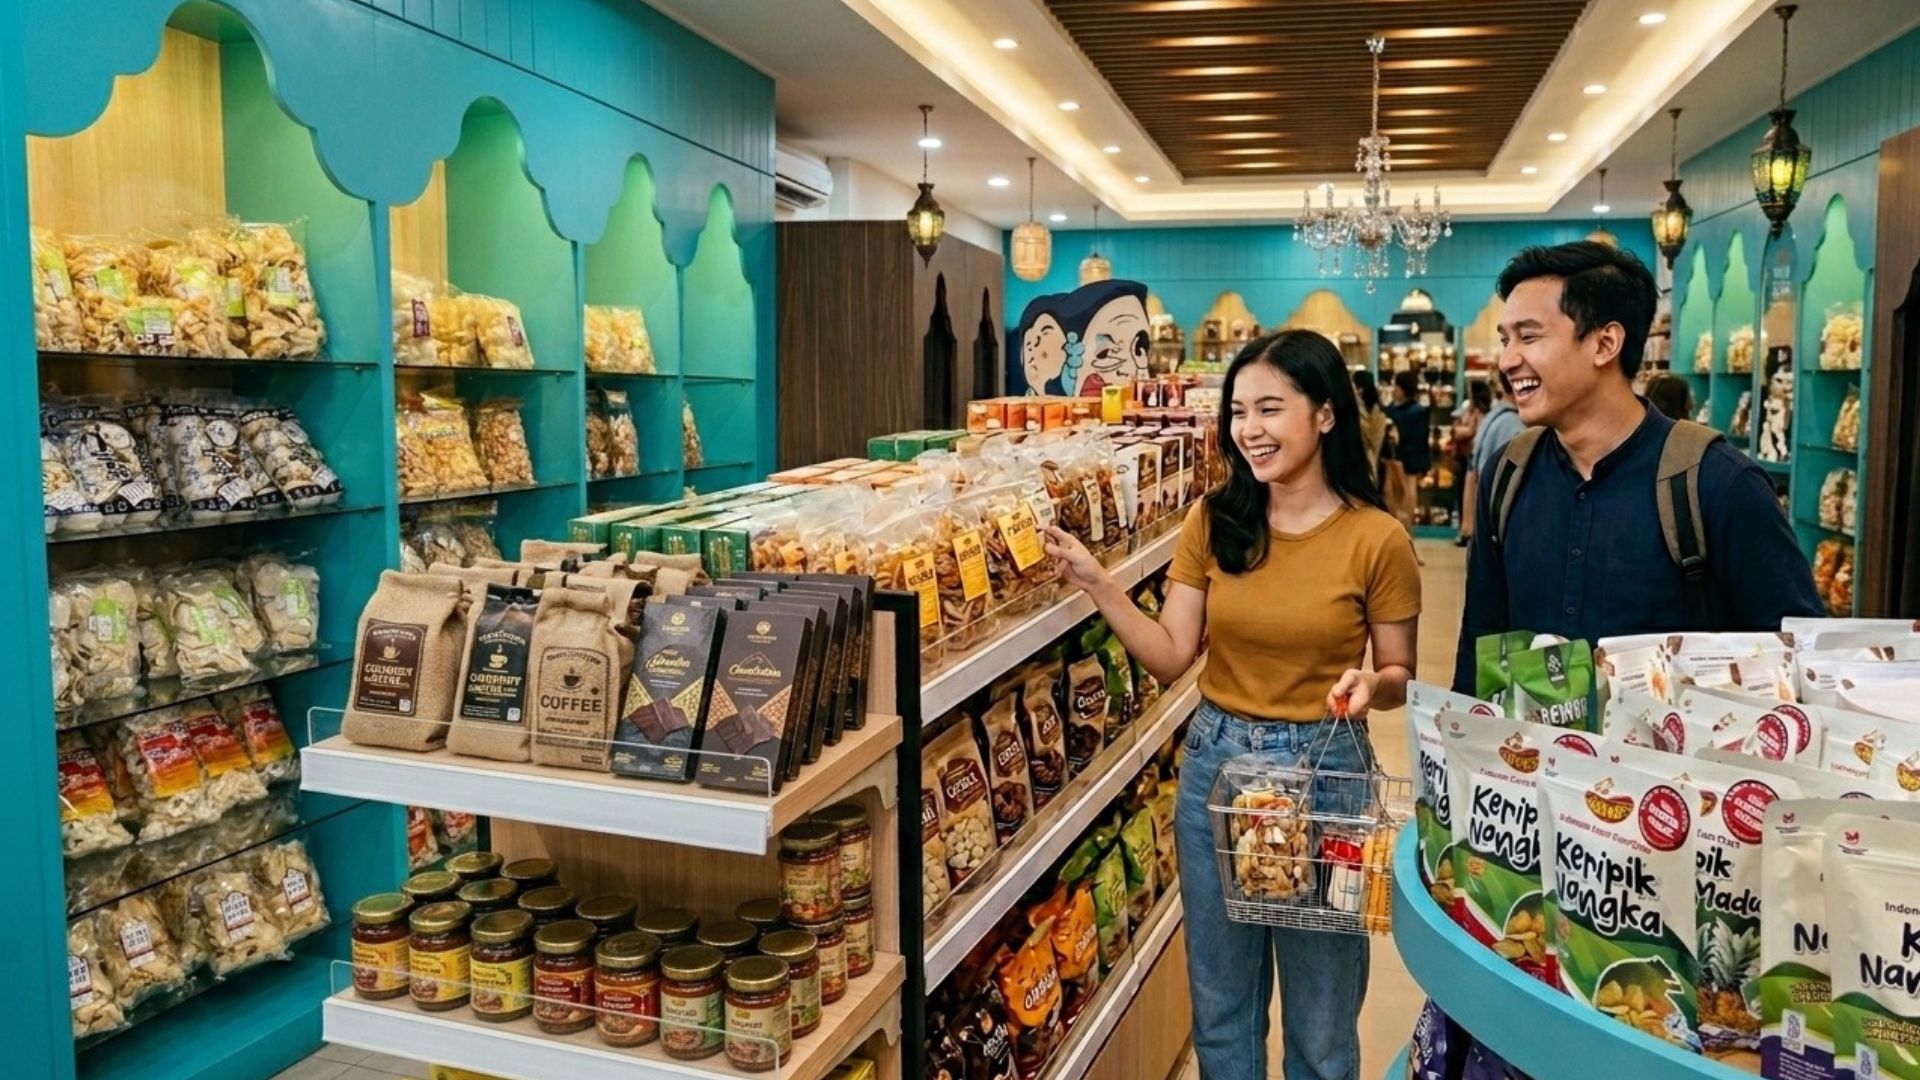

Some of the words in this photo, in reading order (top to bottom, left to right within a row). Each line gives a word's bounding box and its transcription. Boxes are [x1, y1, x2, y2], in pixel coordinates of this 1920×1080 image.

[540, 694, 602, 713] COFFEE
[1473, 785, 1539, 835] Kerip
[1556, 831, 1657, 897] Keripik
[1885, 902, 1920, 915] Indon
